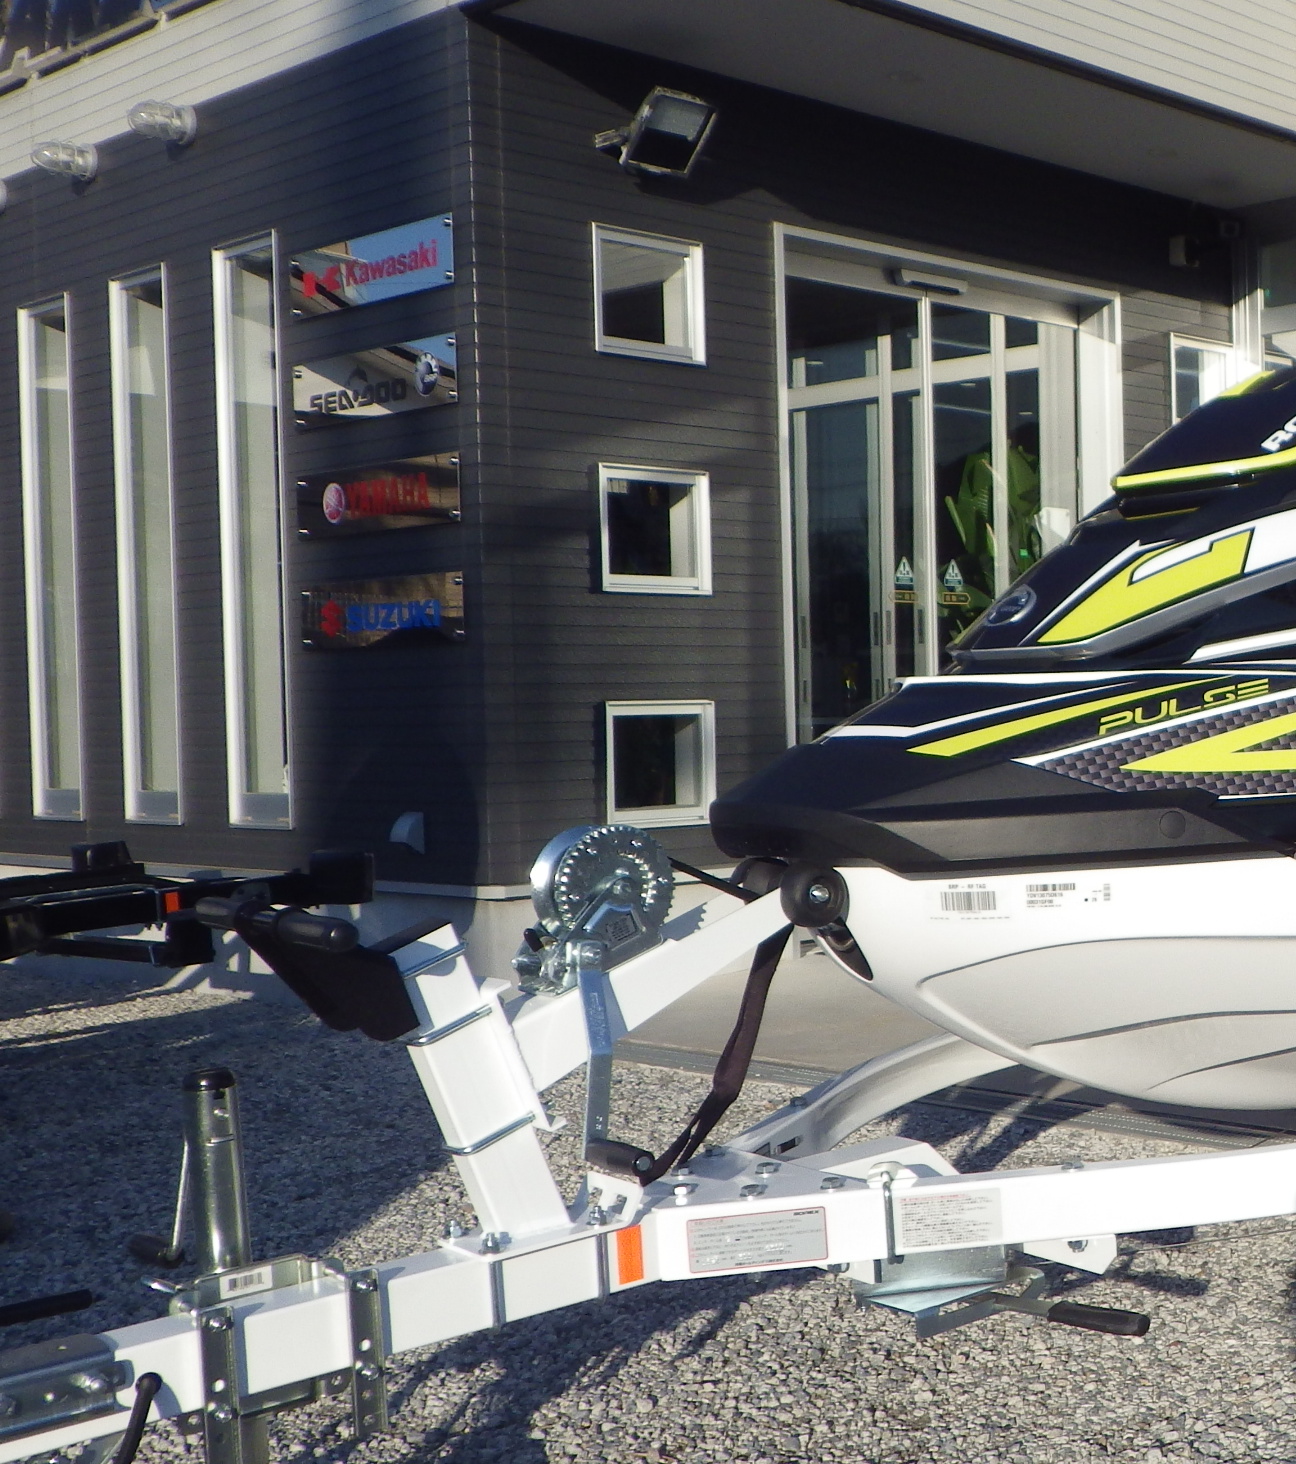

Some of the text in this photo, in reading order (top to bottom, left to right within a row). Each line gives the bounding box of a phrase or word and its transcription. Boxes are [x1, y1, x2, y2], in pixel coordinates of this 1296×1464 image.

[345, 239, 439, 287] Kawasaki
[346, 472, 430, 520] YAMAHA
[346, 599, 441, 632] SUZUKI
[1099, 678, 1269, 735] PULSE
